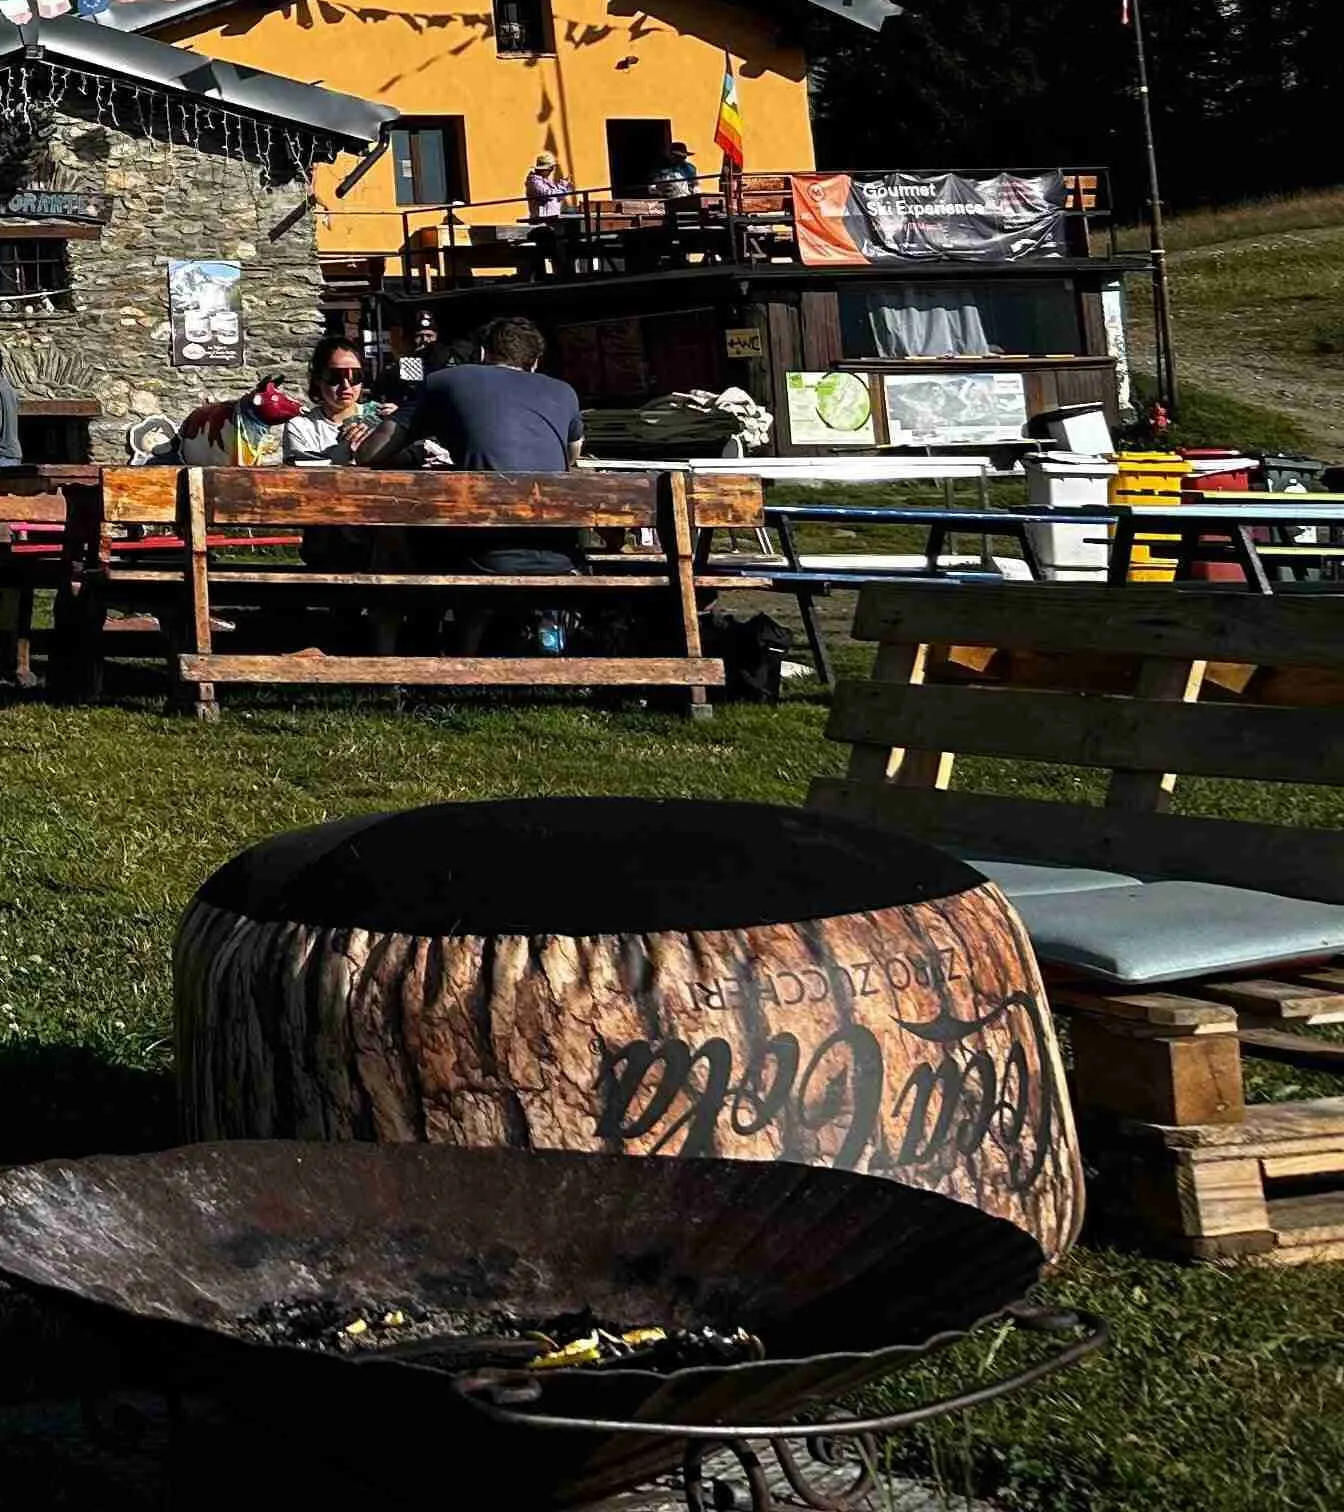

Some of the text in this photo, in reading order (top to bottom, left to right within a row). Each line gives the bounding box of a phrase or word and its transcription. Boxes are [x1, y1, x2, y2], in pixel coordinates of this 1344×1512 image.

[863, 182, 936, 198] Gourmet
[867, 199, 985, 218] Ski Experience
[890, 947, 963, 992] ZRO
